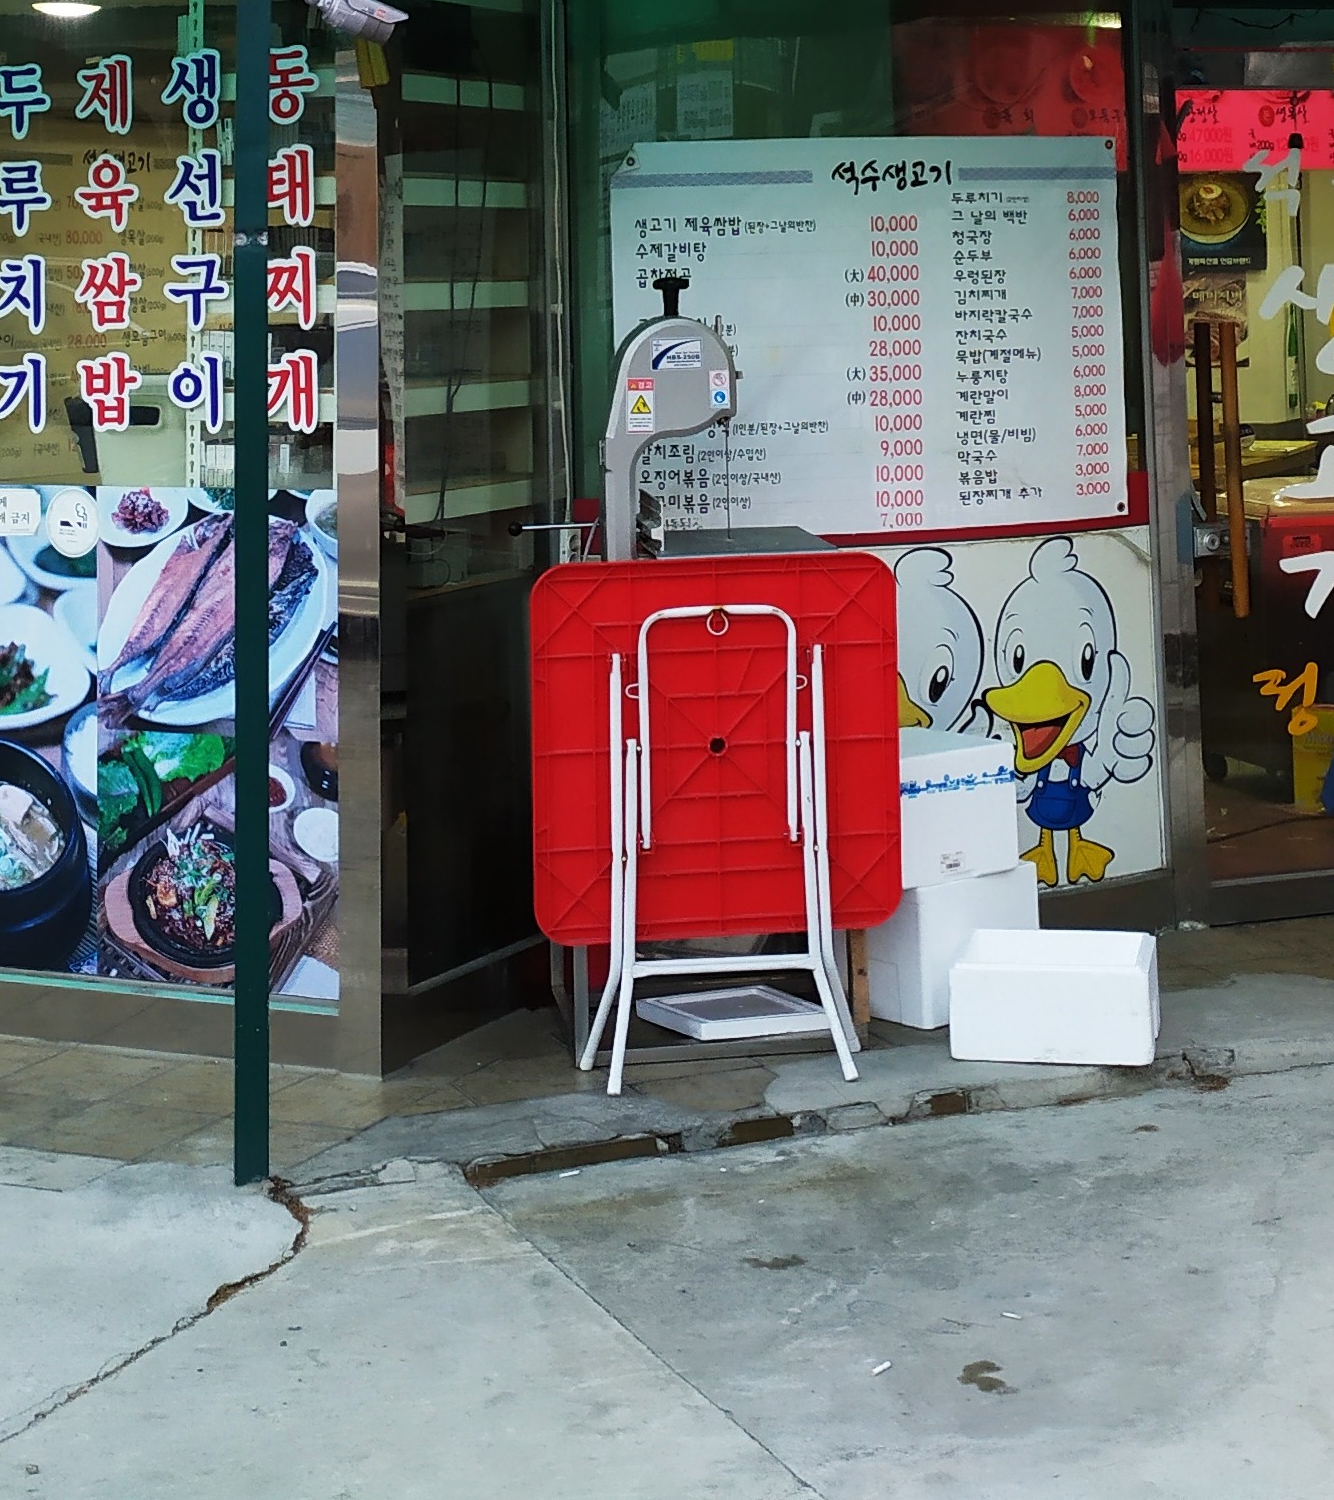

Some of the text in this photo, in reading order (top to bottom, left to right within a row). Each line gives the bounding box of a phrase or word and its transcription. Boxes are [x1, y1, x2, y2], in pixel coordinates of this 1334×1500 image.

[831, 159, 952, 196] 석수생고기
[951, 192, 1003, 204] 두루치기
[1067, 191, 1100, 204] 8,000
[635, 215, 918, 239] 생고기 제육쌈밥 10,000
[1003, 209, 1027, 225] 백반
[1068, 209, 1100, 222] 6,000
[76, 54, 142, 431] 제육쌈밥
[162, 48, 229, 432] 생선구이
[267, 45, 319, 433] 동태찌개
[952, 228, 1100, 246] 청국장 6,000
[635, 240, 919, 262] 수제갈비탕 10,000
[953, 247, 1101, 265] 순두부 6,000
[867, 265, 919, 284] 40,000
[953, 266, 1102, 285] 우렁된장 6,000
[867, 290, 920, 309] 30,000
[954, 285, 1103, 305] 김치찌개 7,000
[873, 314, 921, 334] 10,000
[954, 305, 1103, 324] 바지락칼국수 7,000
[955, 325, 1104, 346] 잔치국수 5,000
[869, 339, 921, 358] 28,000
[1072, 344, 1105, 358] 5,000
[869, 364, 922, 383] 35,000
[956, 364, 1106, 386] 누룽지탕 6,000
[870, 389, 922, 408] 28,000
[956, 384, 1106, 405] 계란말이 8,000
[875, 414, 923, 433] 10,000
[956, 403, 1107, 425] 계란찜 5,000
[1075, 422, 1108, 437] 6,000
[880, 439, 923, 459] 9,000
[957, 442, 1108, 465] 막국수 7,000
[639, 468, 710, 490] 오징어볶음
[876, 464, 923, 484] 10,000
[958, 462, 1109, 486] 볶음밥 3,000
[876, 489, 923, 509] 10,000
[959, 481, 1110, 506] 된장찌개 추가 3,000
[10, 512, 30, 524] 금지
[880, 512, 923, 528] 7,000
